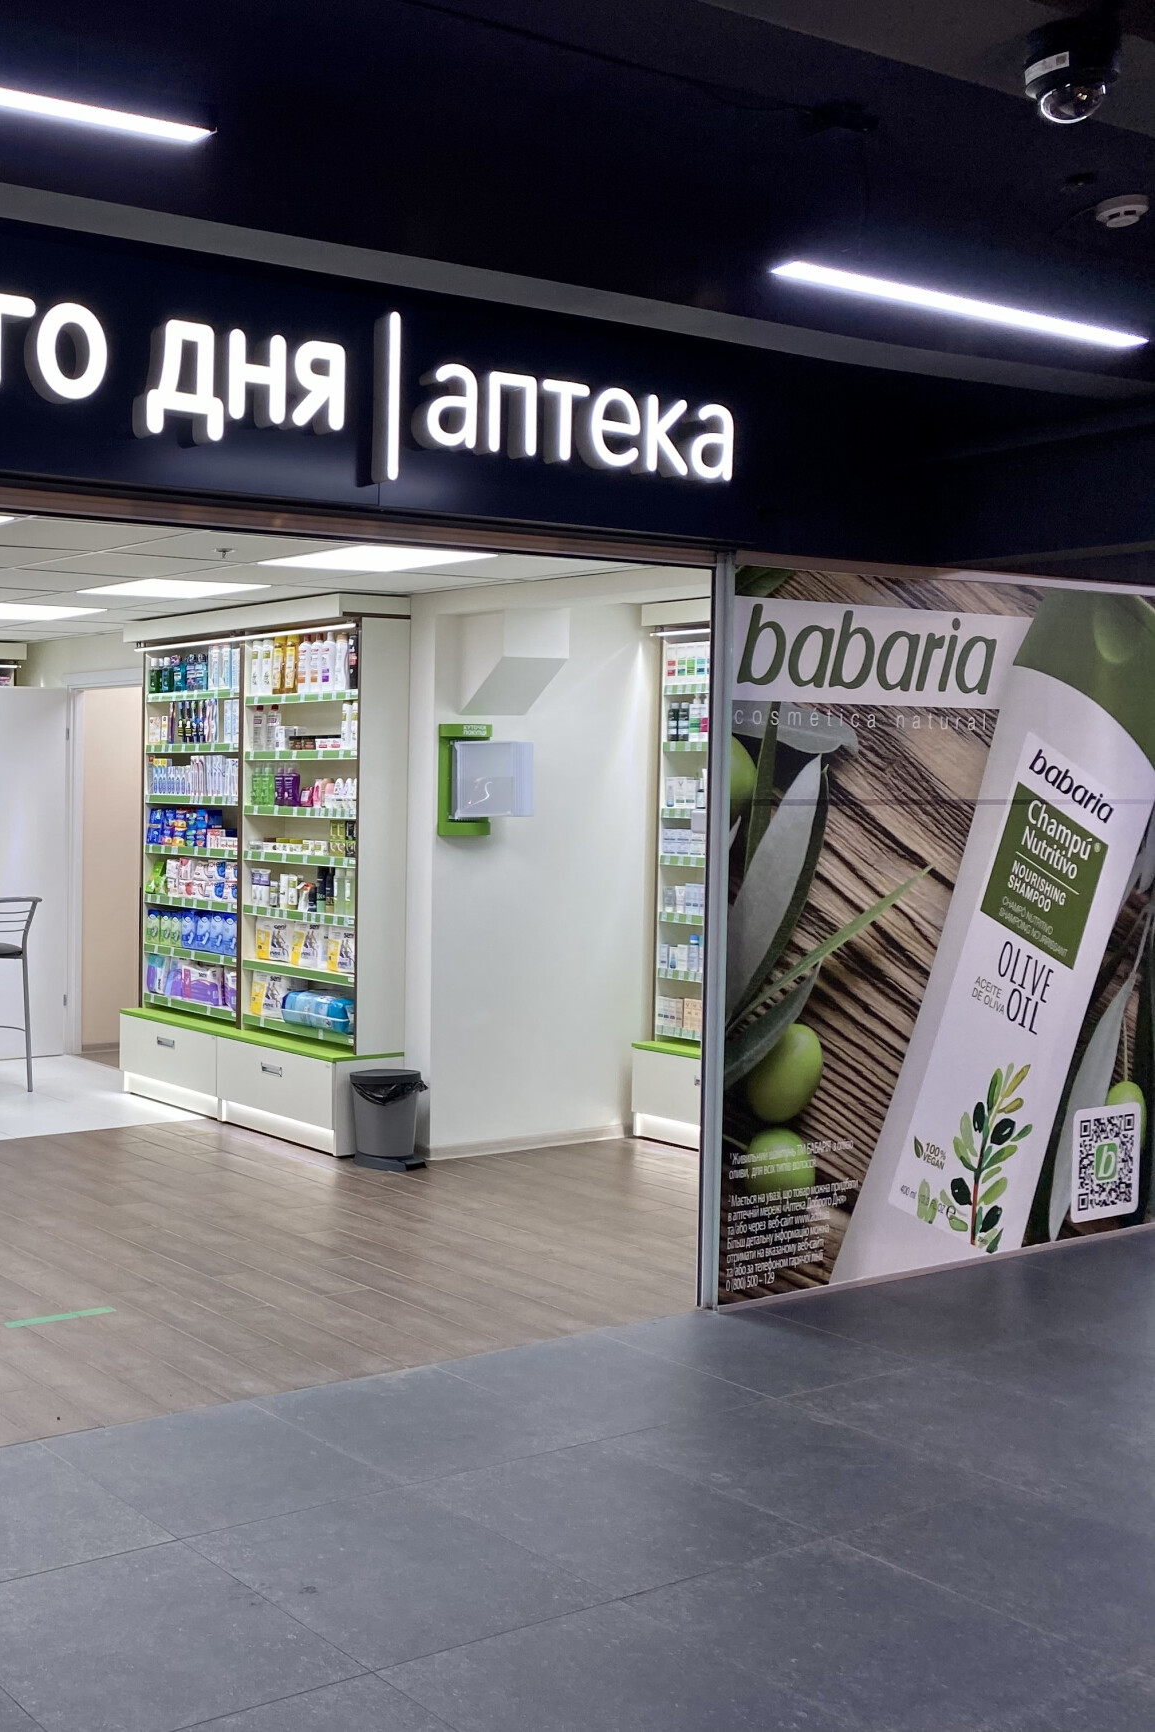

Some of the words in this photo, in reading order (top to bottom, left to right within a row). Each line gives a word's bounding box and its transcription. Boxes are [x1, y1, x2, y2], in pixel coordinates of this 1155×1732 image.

[145, 318, 347, 442] дня
[426, 362, 735, 482] аптека
[737, 603, 998, 695] babaria
[733, 708, 877, 729] cosmética
[895, 713, 988, 731] natural
[1028, 748, 1114, 824] babaria
[1021, 826, 1079, 880] Nutritivo
[1027, 800, 1093, 861] Champú
[1007, 874, 1052, 913] SHAMPOO
[1011, 860, 1066, 906] NOURISHING
[998, 940, 1054, 1003] OLIVE
[971, 987, 983, 1001] DE
[984, 995, 1004, 1015] OLIVA
[1006, 987, 1038, 1036] OIL
[923, 1153, 945, 1170] VEGAN
[926, 1142, 946, 1160] 100%
[747, 1274, 758, 1288] 500
